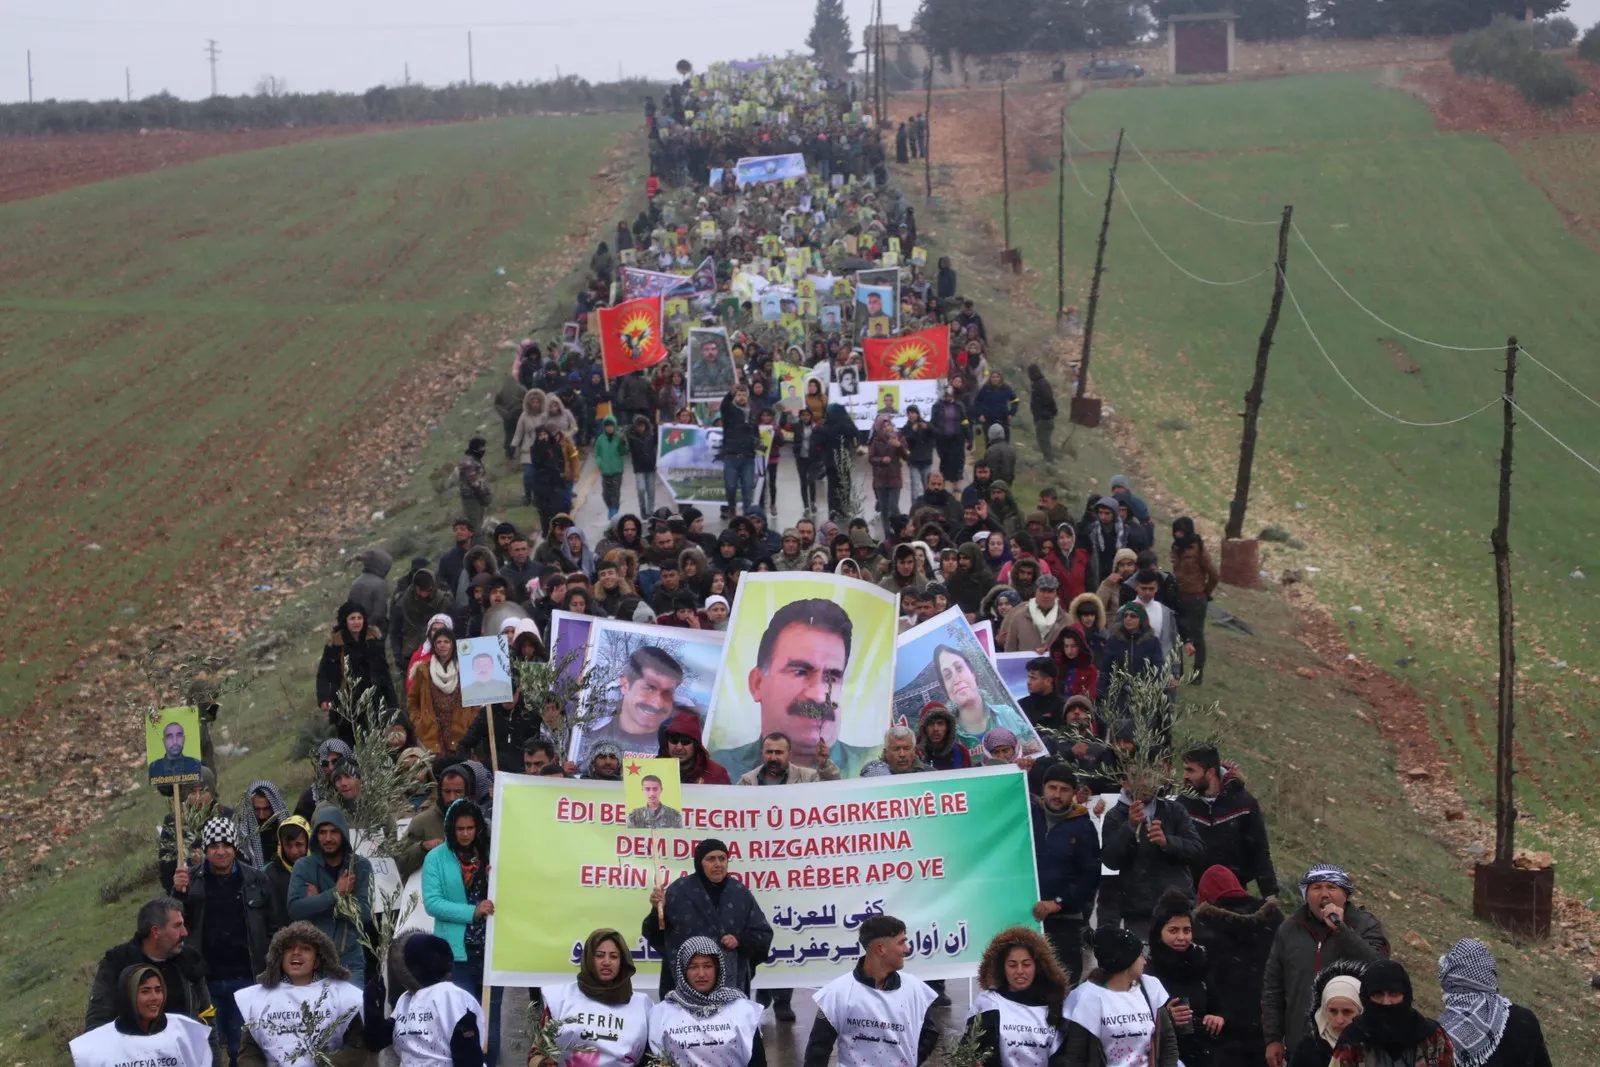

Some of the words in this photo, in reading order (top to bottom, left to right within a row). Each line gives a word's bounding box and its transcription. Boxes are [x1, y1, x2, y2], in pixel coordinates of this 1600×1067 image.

[557, 797, 594, 822] ÊDI
[600, 803, 627, 824] BE
[682, 807, 760, 829] TECRIT
[767, 806, 783, 828] Û
[790, 793, 935, 828] DAGIRKERIYÊ
[941, 793, 967, 814] RE
[616, 835, 666, 858] DEM
[749, 830, 912, 859] RIZGARKIRINA
[581, 864, 647, 888] EFRÎN
[788, 865, 859, 888] RÊBER
[866, 862, 913, 883] APO
[918, 858, 943, 878] YE
[773, 904, 836, 931] للعزلة
[944, 922, 966, 954] آن
[578, 1013, 624, 1030] EFRÎN
[848, 1017, 880, 1029] NAVÇEYA
[1101, 1013, 1137, 1026] NAVÇEYA
[580, 1029, 619, 1042] عفرين
[670, 1024, 701, 1035] NAVÇEYA
[1003, 1024, 1032, 1034] NAVÇEYA
